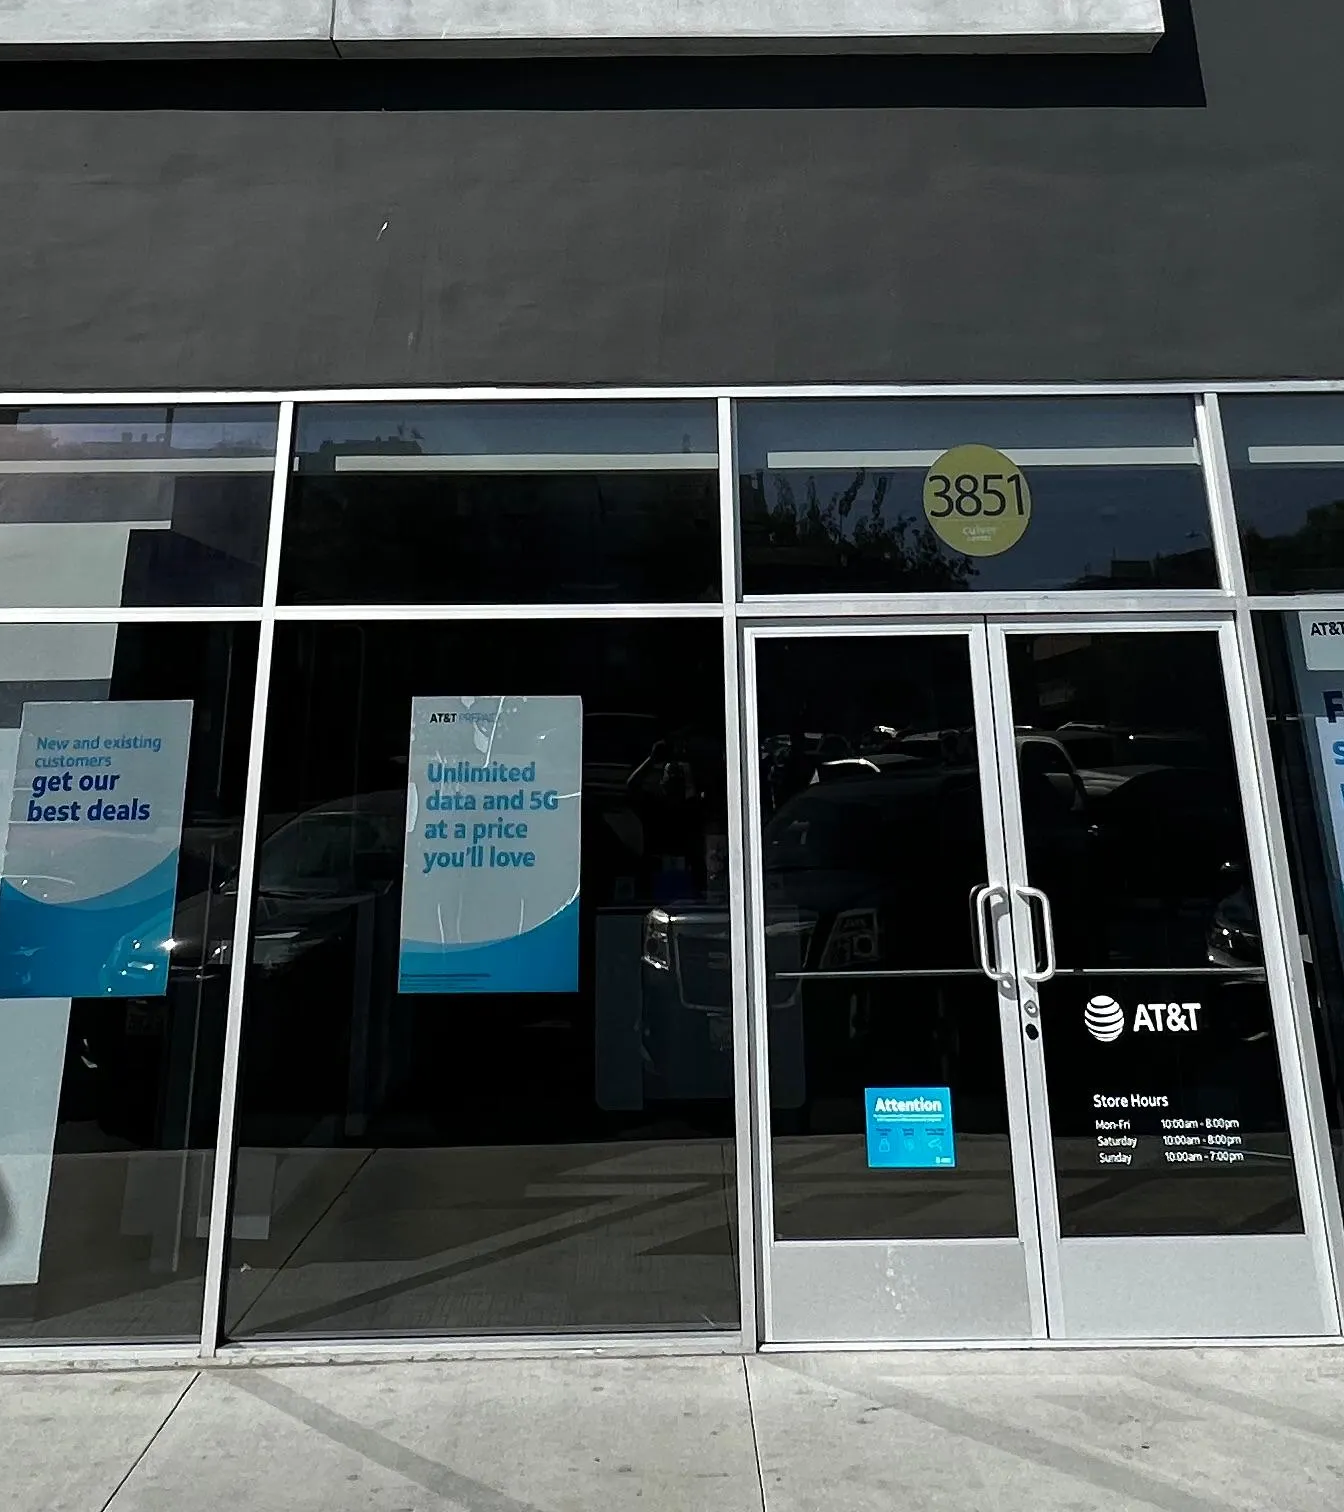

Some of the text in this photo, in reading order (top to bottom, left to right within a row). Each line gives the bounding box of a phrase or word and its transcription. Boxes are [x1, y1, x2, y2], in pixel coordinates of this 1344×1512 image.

[928, 473, 1025, 518] 3851
[429, 713, 457, 724] AT&T
[36, 733, 161, 752] New and existing
[34, 755, 112, 768] customers
[427, 761, 536, 783] Unlimited
[32, 771, 120, 798] get our
[27, 798, 151, 822] best deals
[425, 790, 559, 811] data and 5G
[424, 817, 528, 844] at a price
[422, 845, 536, 874] you'll love
[1133, 1003, 1202, 1032] AT&T
[875, 1096, 943, 1112] Attention
[1093, 1093, 1169, 1108] Store Hours
[1095, 1119, 1131, 1130] Mon-Fri
[1097, 1136, 1138, 1148] Saturday
[1099, 1152, 1132, 1165] Sunday
